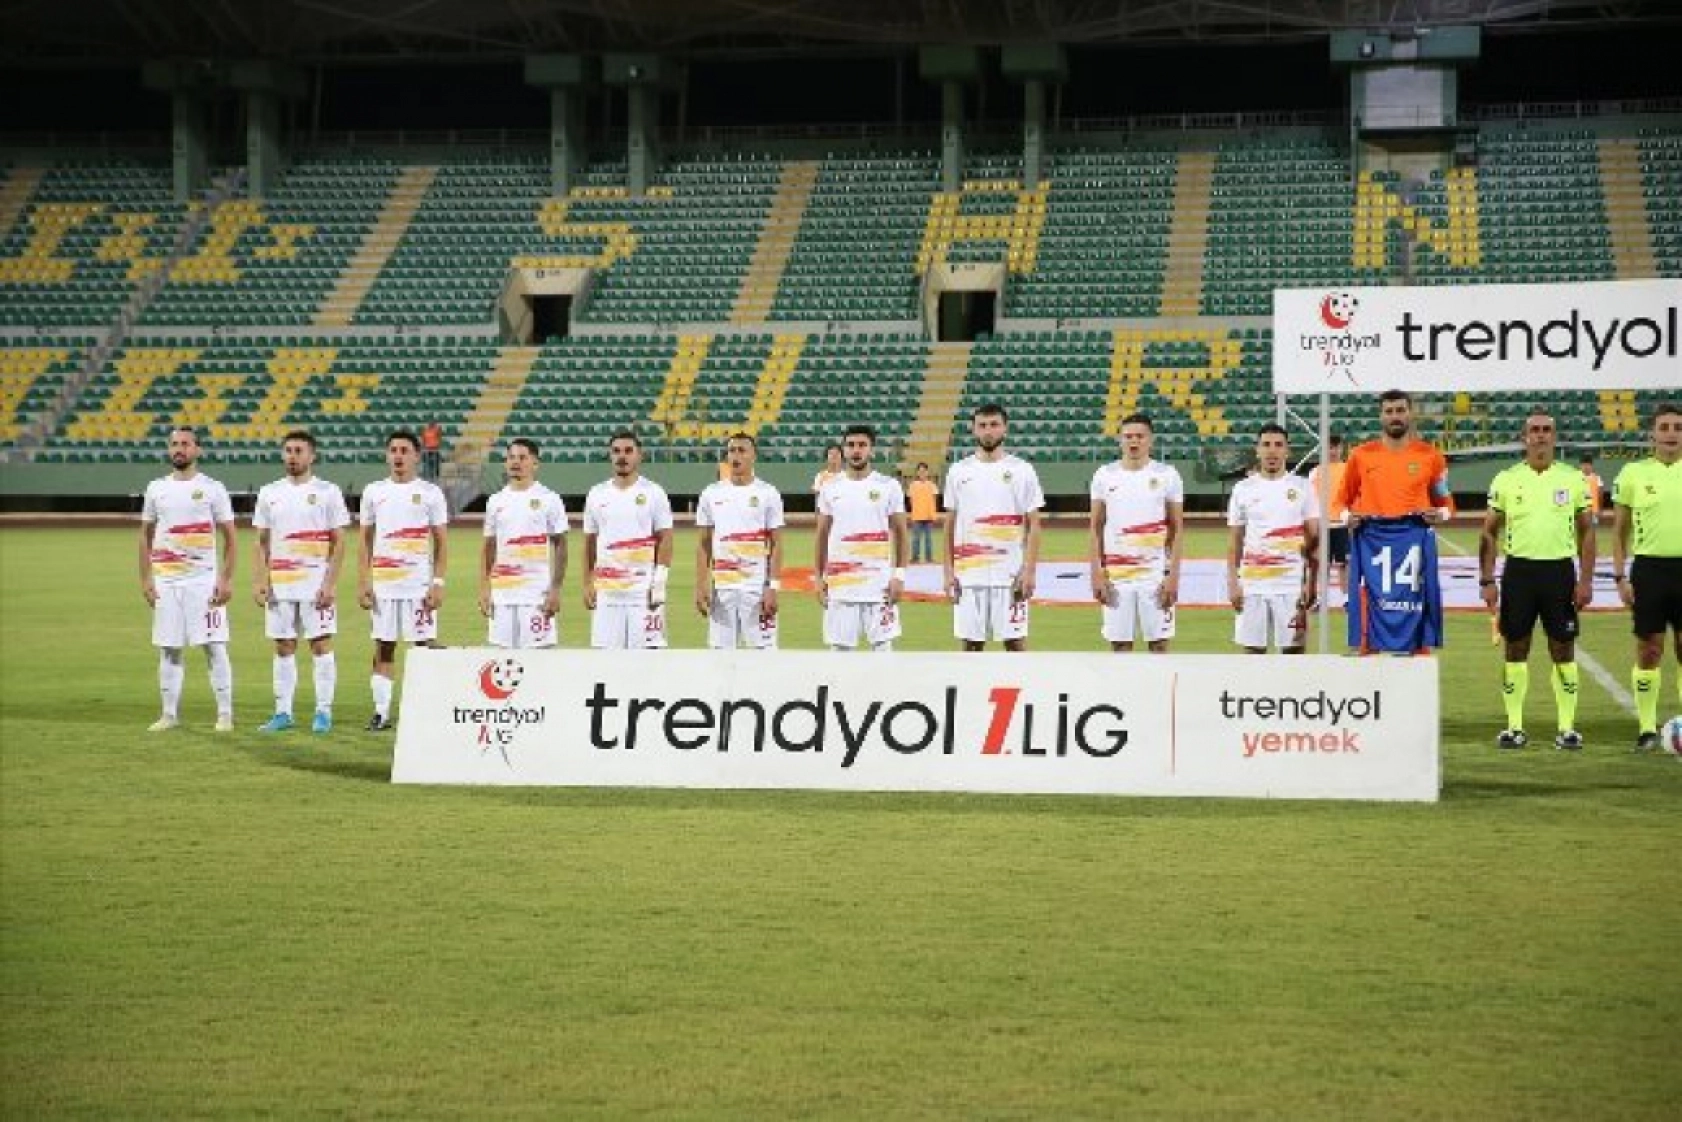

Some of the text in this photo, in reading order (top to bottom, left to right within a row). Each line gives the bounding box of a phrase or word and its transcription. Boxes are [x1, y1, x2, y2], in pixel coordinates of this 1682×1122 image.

[1300, 332, 1380, 352] trendyol
[1395, 306, 1678, 371] trendyol
[1371, 545, 1422, 593] 14
[203, 610, 222, 629] 10
[453, 706, 545, 728] trendyol
[1219, 689, 1382, 726] trendyol
[585, 683, 957, 768] trendyol
[1241, 728, 1361, 758] yemek
